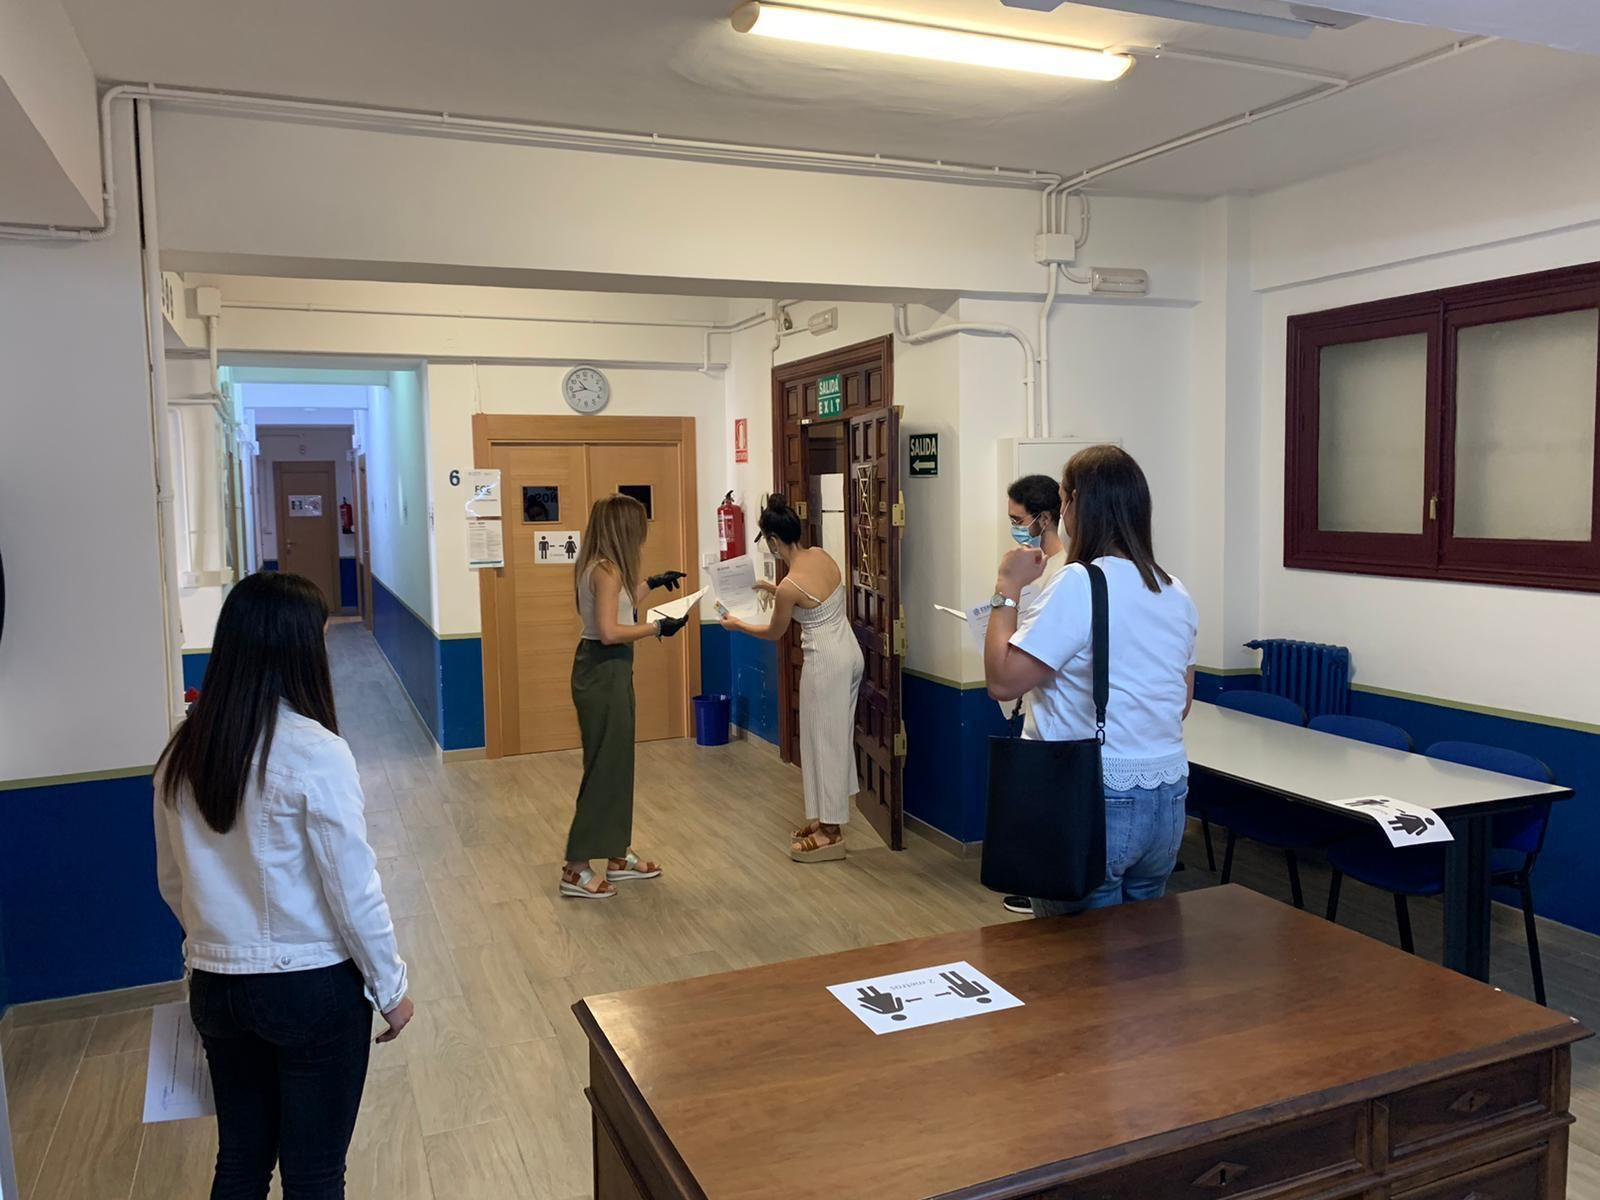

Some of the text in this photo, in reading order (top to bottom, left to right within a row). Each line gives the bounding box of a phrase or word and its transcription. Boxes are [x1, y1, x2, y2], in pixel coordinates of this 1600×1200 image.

[819, 378, 840, 395] SALIDA
[818, 398, 841, 415] EXIT
[910, 437, 937, 456] SALIDA
[449, 469, 461, 487] 6
